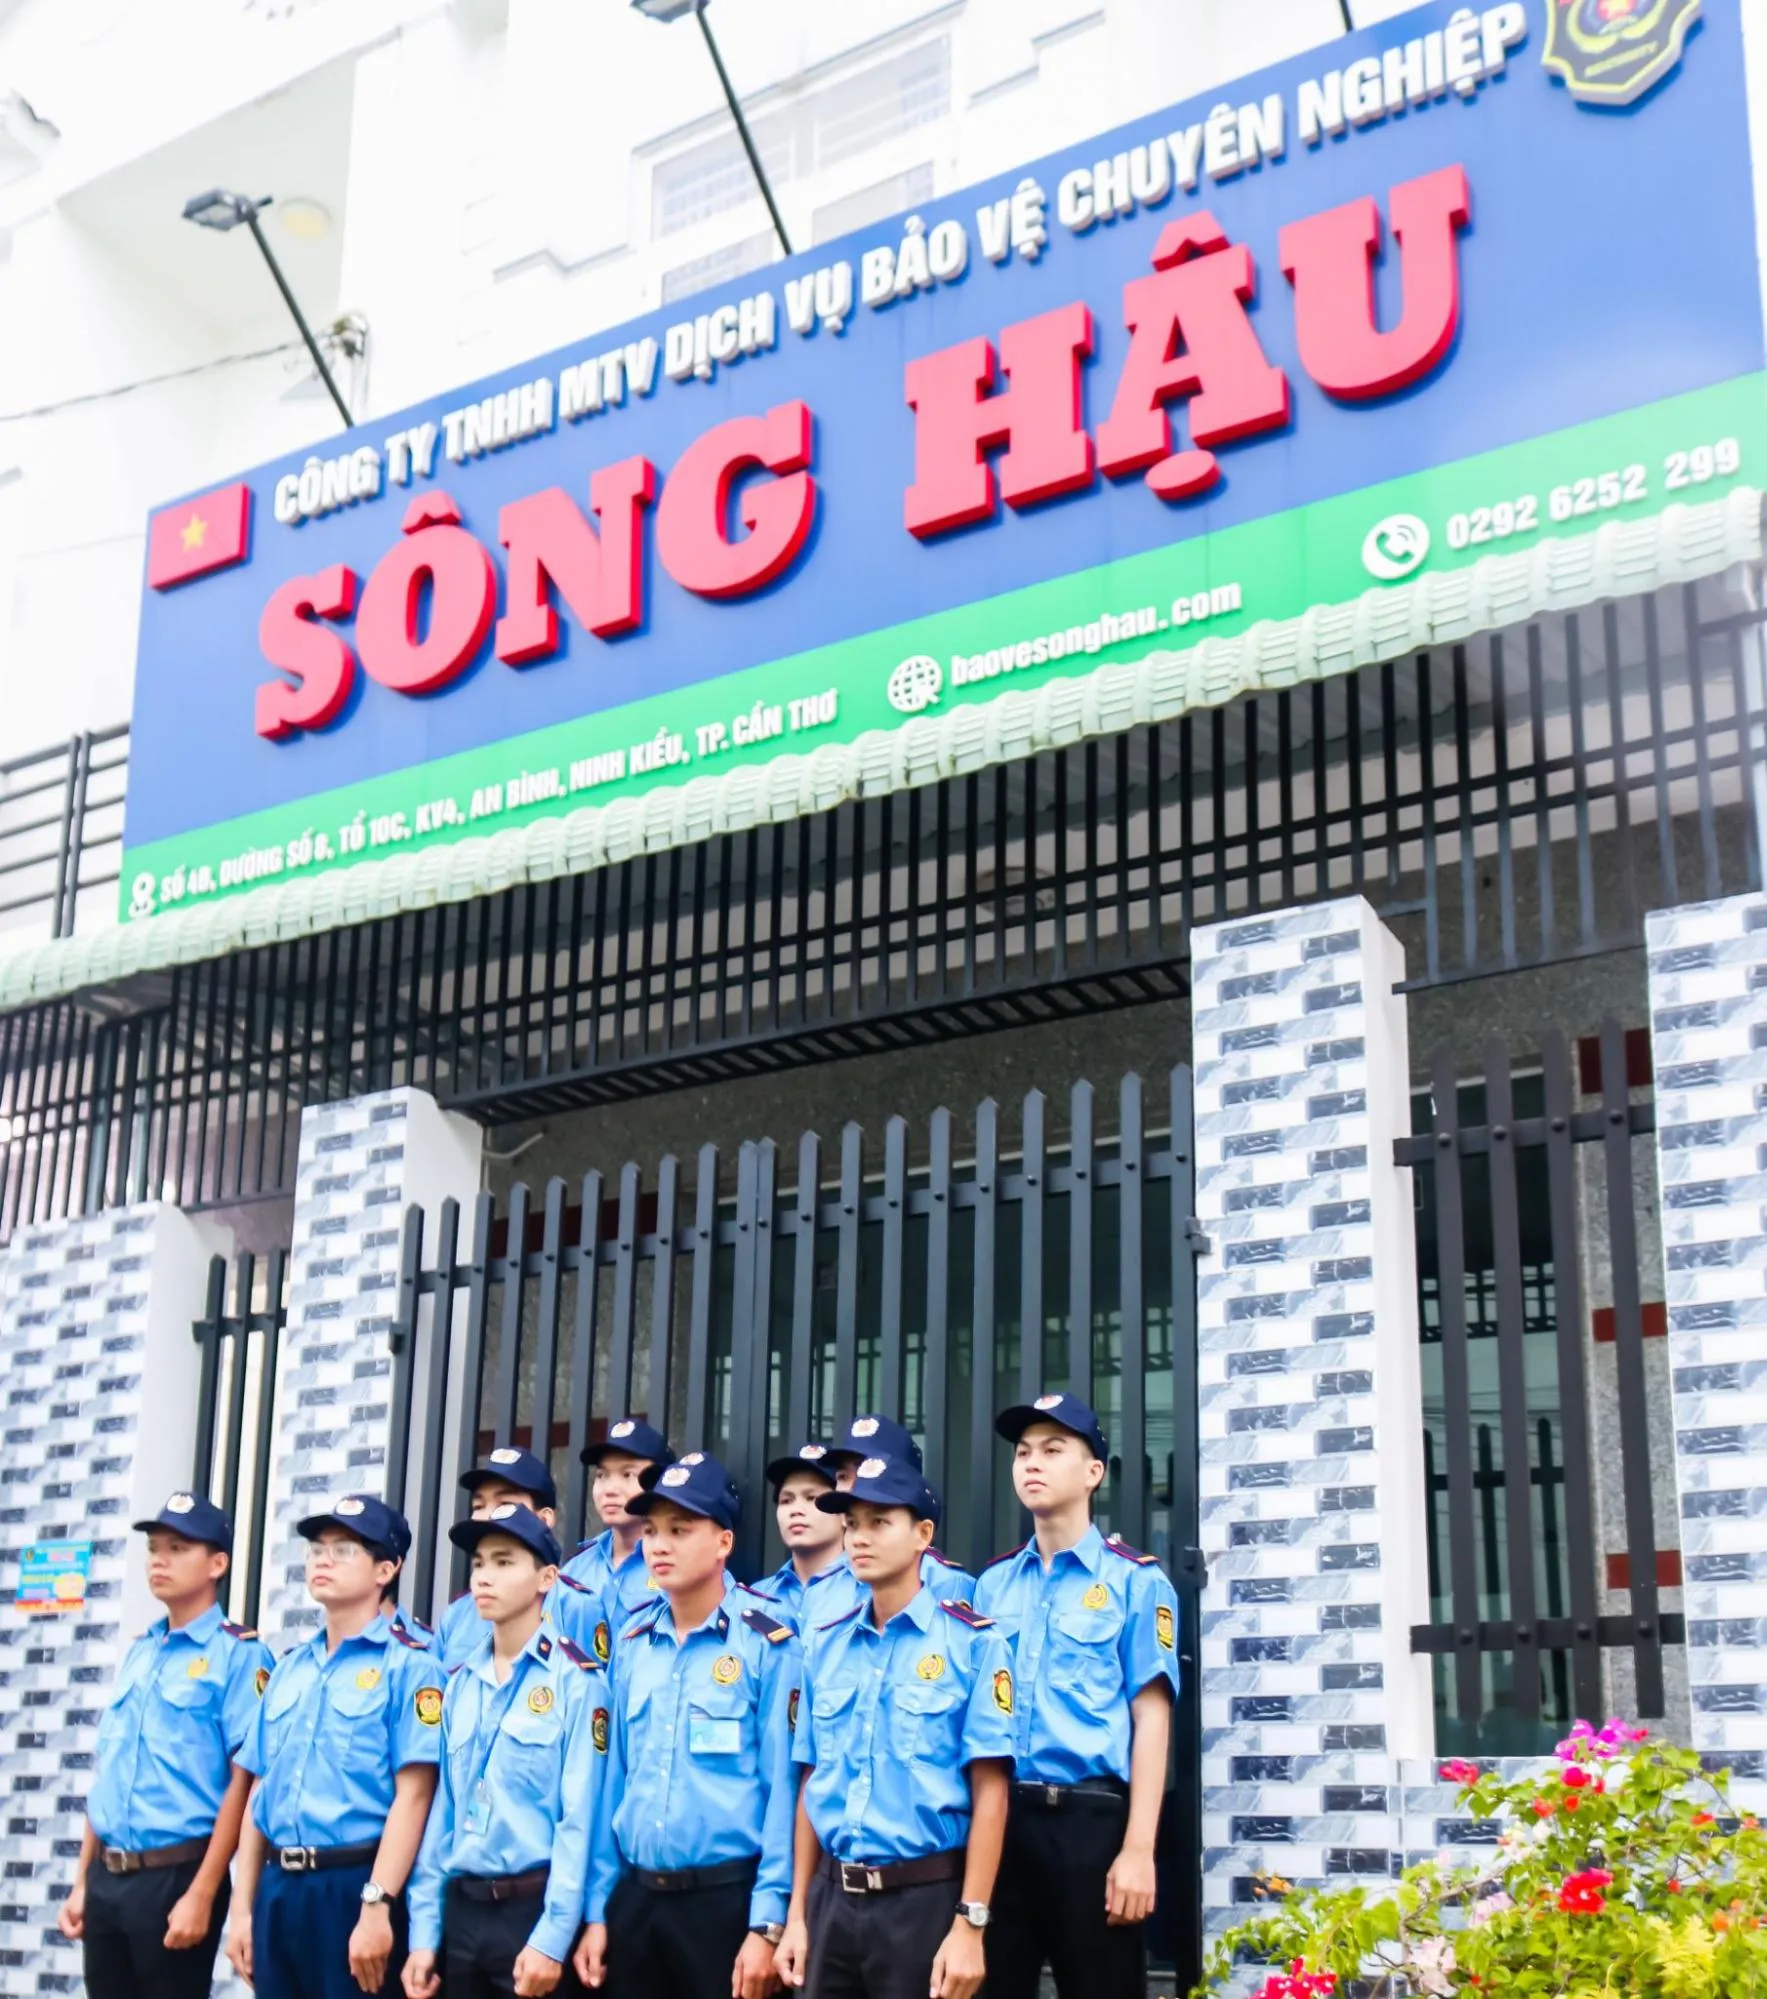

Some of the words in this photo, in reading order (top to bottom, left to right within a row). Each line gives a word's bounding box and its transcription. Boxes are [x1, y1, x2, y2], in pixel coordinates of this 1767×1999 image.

[274, 446, 381, 525] CÔNG
[385, 422, 438, 485] TY
[442, 377, 553, 461] TNHH
[558, 336, 658, 422] MTV
[665, 291, 775, 380] DỊCH
[784, 260, 853, 332] VỤ
[862, 214, 968, 308] BẢO
[976, 178, 1047, 261] VỆ
[1058, 93, 1285, 233] CHUYÊN
[1297, 1, 1527, 145] NGHIỆP
[254, 399, 817, 741] SÔNG
[905, 163, 1470, 538] HẬU
[1446, 495, 1538, 550] 0292
[1548, 463, 1647, 521] 6252
[1663, 437, 1740, 490] 299
[286, 827, 313, 868] SỐ
[470, 784, 502, 819] AN
[569, 750, 626, 791] NINH
[695, 722, 728, 756] TP.
[732, 700, 783, 745] CẦN
[787, 688, 838, 730] THƠ
